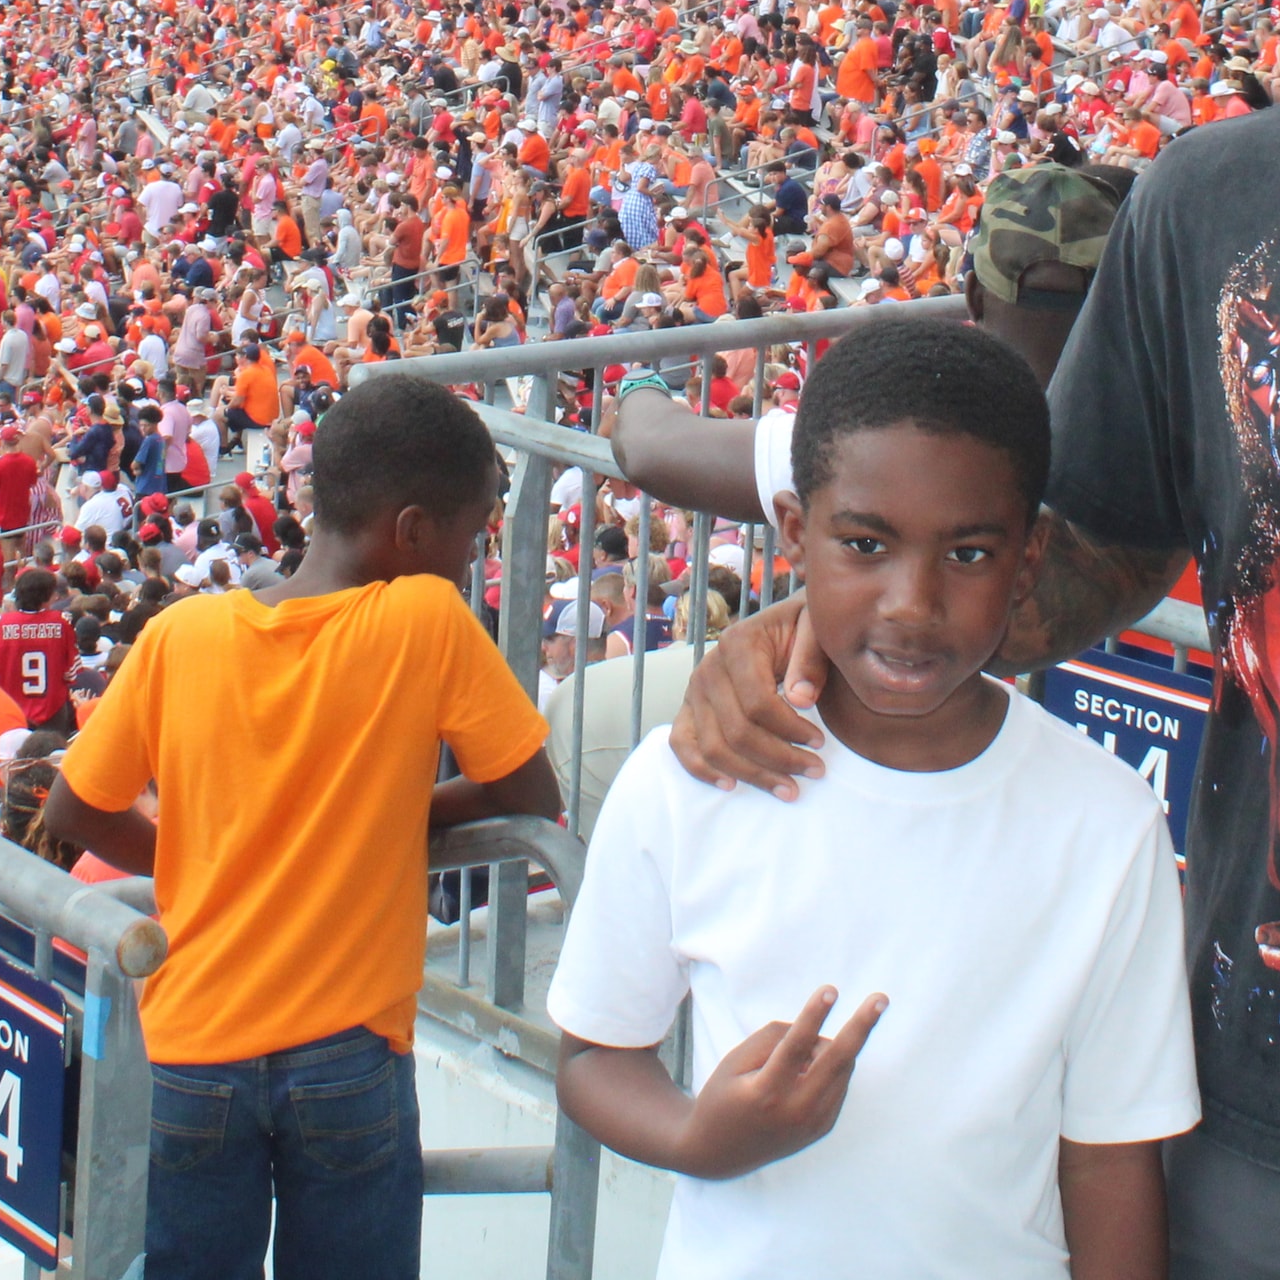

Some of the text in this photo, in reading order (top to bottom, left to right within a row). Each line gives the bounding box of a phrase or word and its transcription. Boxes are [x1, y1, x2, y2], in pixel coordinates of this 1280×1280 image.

[2, 624, 62, 640] NC STATE
[22, 651, 47, 696] 9
[1074, 689, 1180, 740] SECTION
